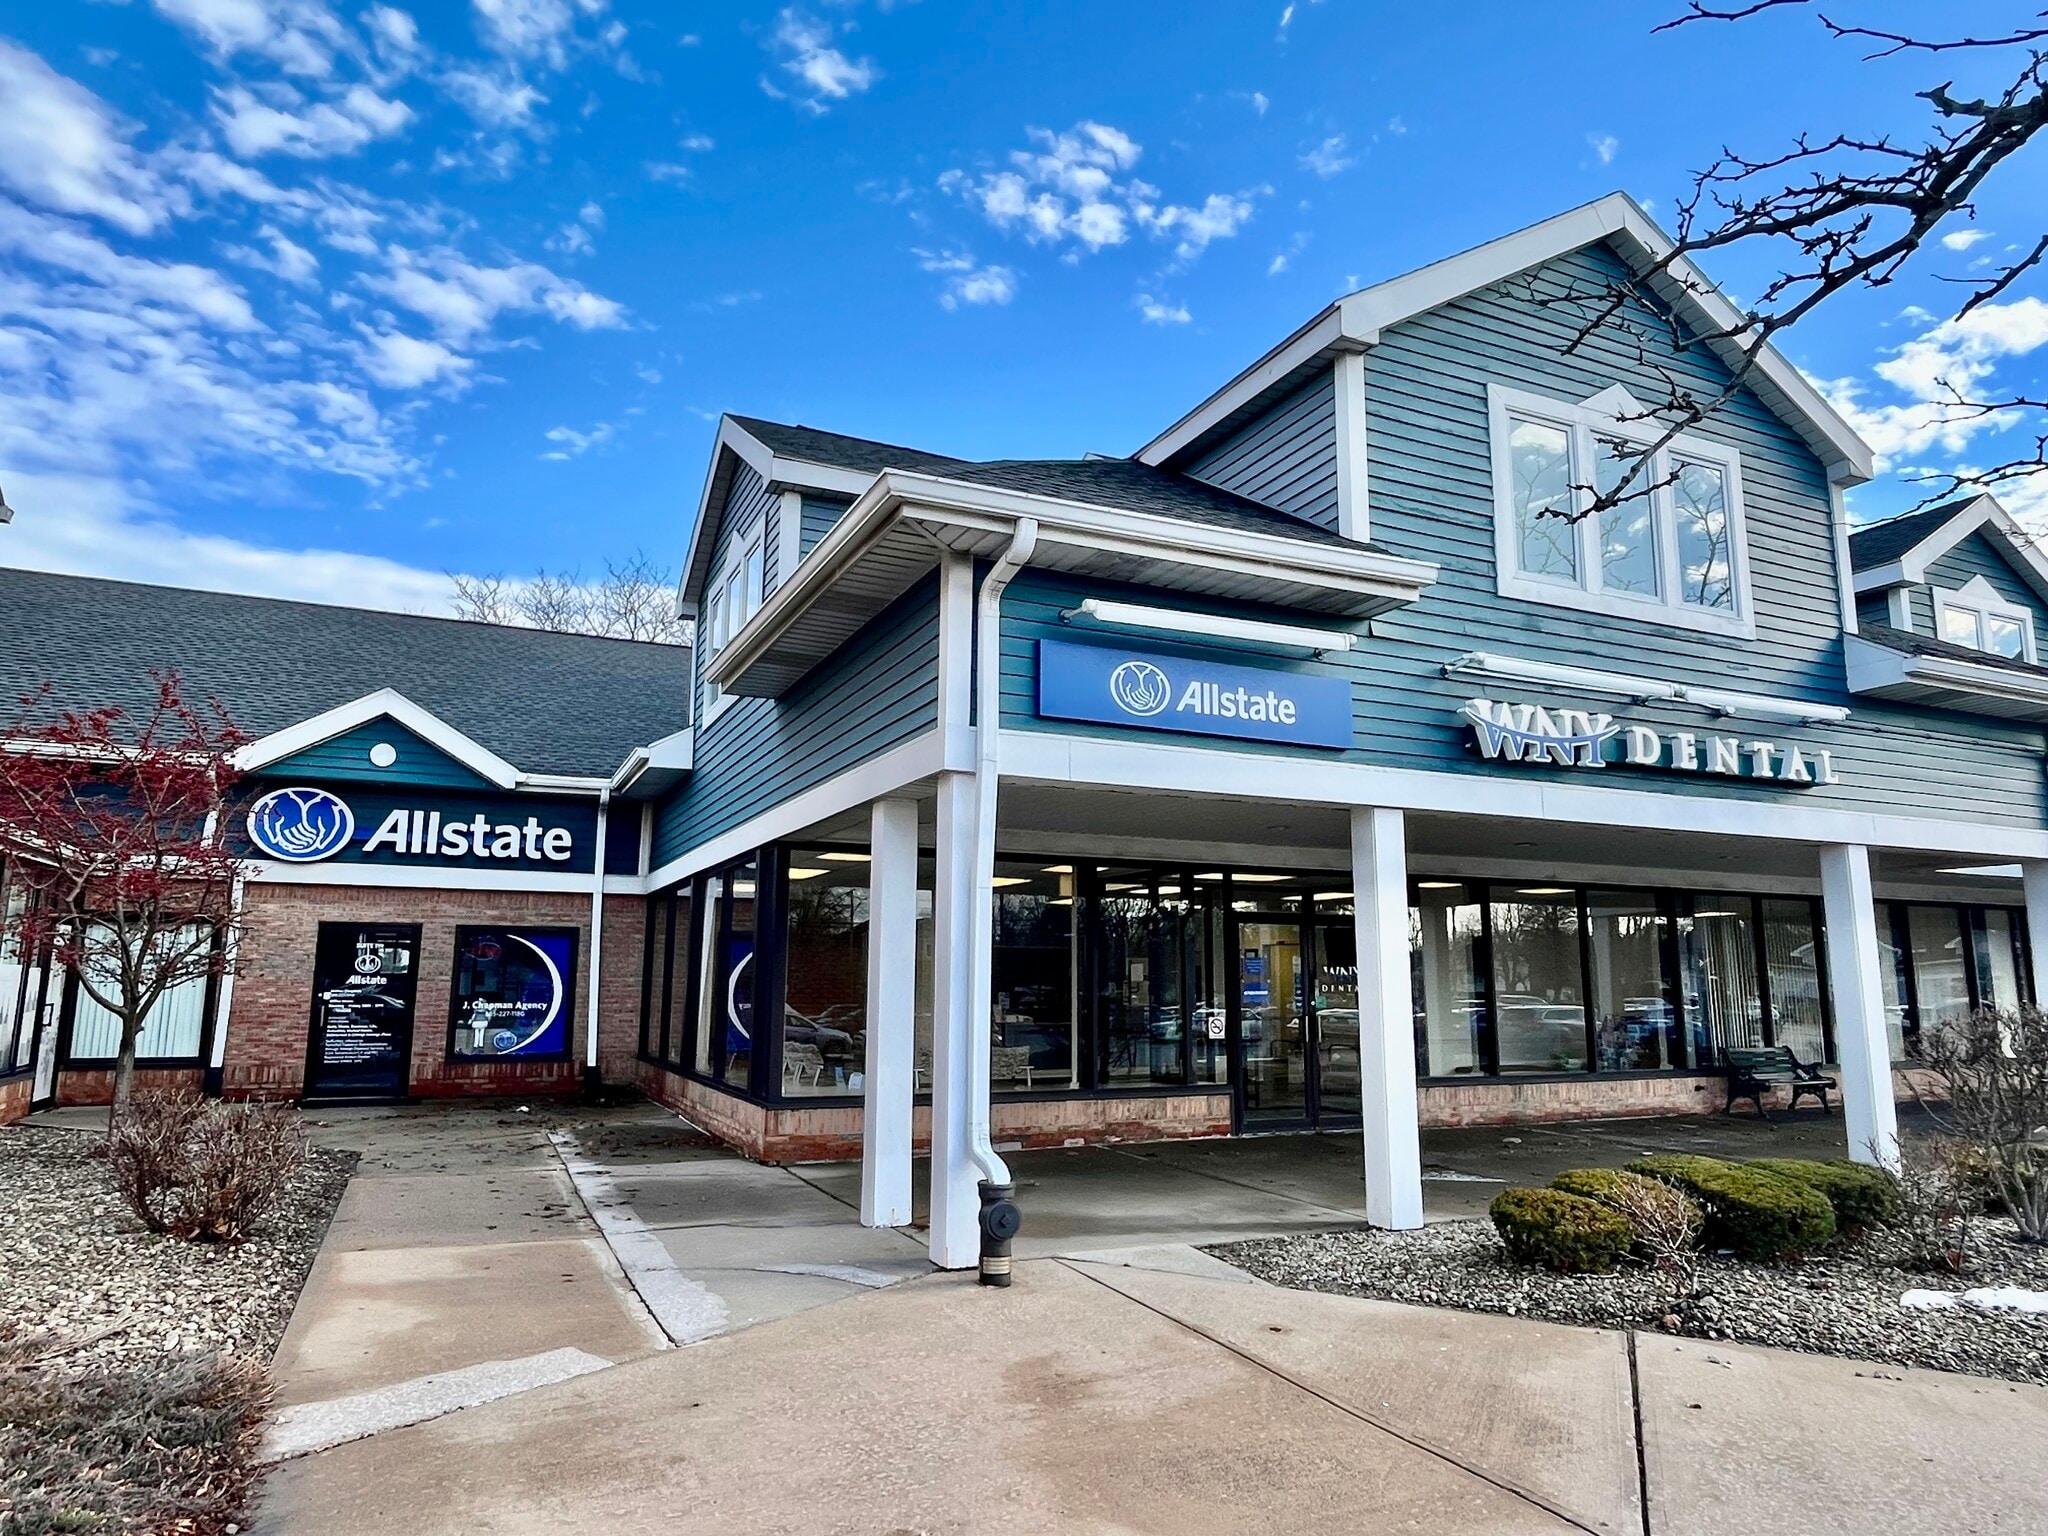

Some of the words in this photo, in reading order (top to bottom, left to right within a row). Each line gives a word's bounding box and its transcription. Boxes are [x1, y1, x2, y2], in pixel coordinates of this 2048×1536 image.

[1176, 680, 1297, 725] Allstate
[1460, 698, 1612, 768] WNY
[1624, 725, 1839, 785] DENTAL
[361, 809, 573, 861] Allstate
[345, 974, 388, 985] Allstate
[462, 1001, 470, 1010] J.
[472, 1001, 513, 1010] Chapman
[515, 1001, 547, 1011] Agency
